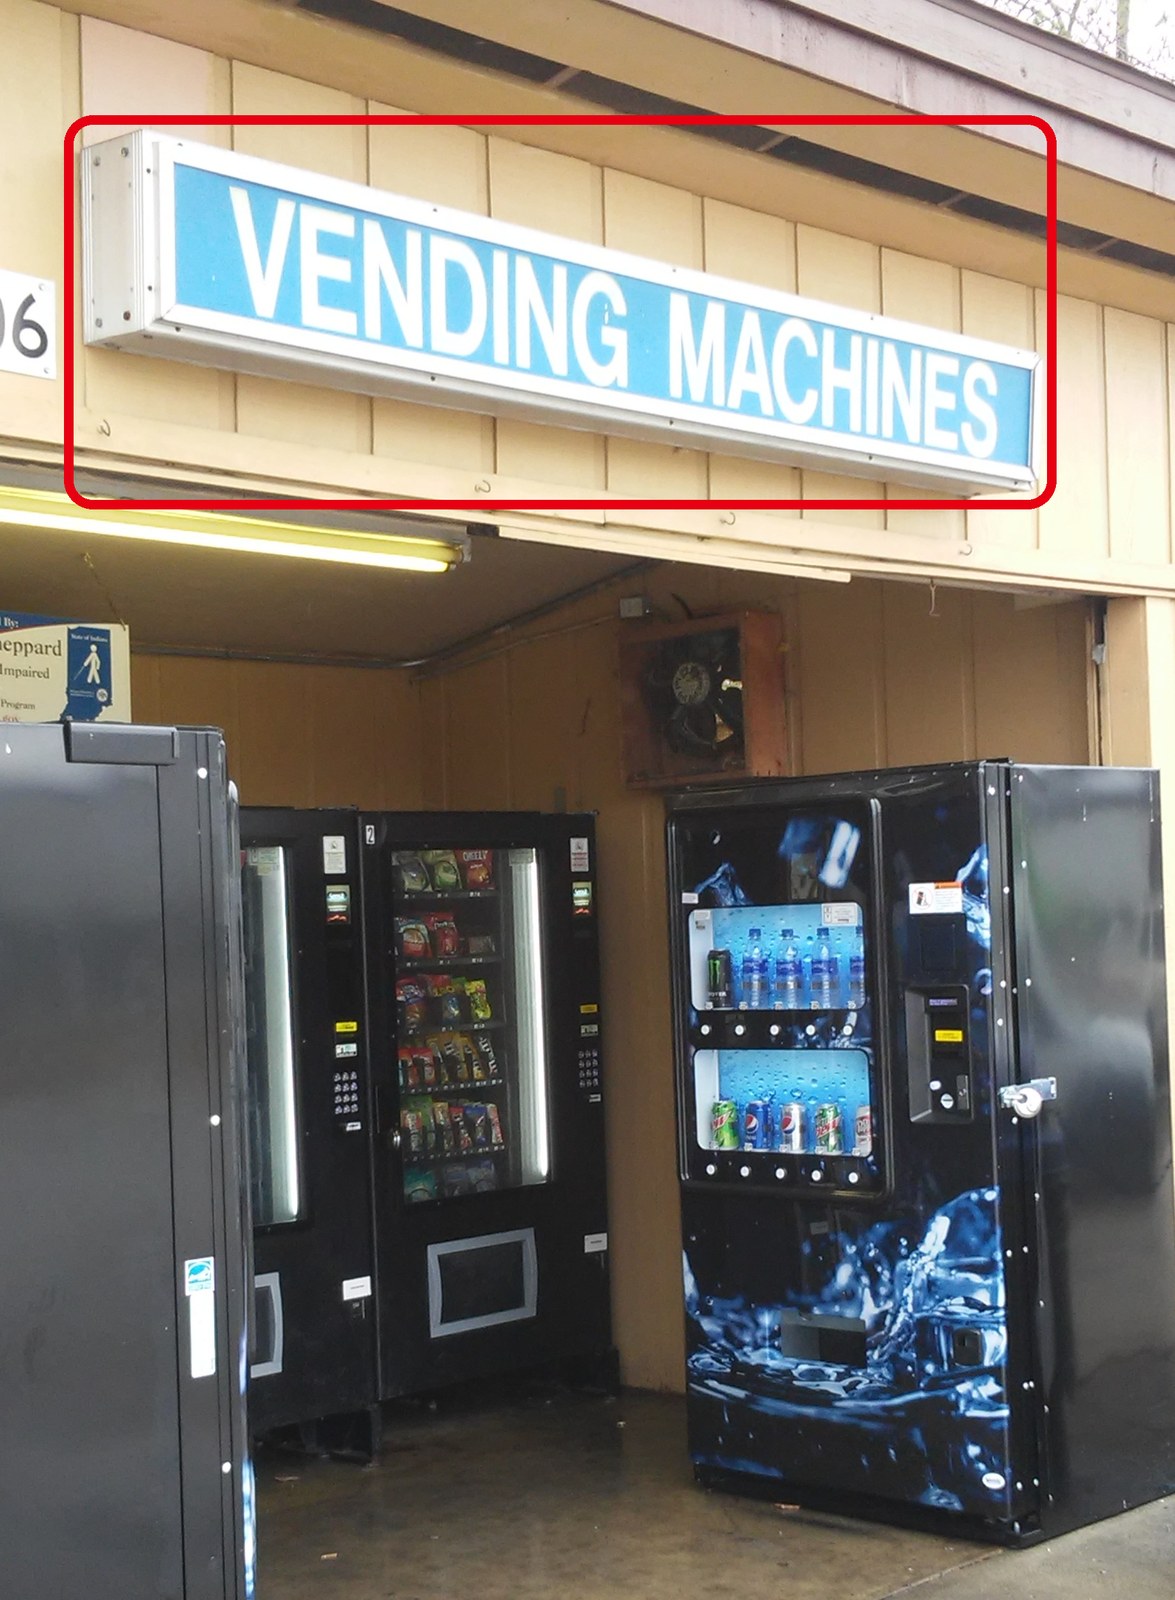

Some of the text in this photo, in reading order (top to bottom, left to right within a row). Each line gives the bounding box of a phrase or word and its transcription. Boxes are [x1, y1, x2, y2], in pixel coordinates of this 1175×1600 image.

[229, 185, 999, 459] VENDING MACHINES
[3, 617, 19, 630] By:
[0, 698, 36, 710] Program
[367, 827, 374, 843] 2
